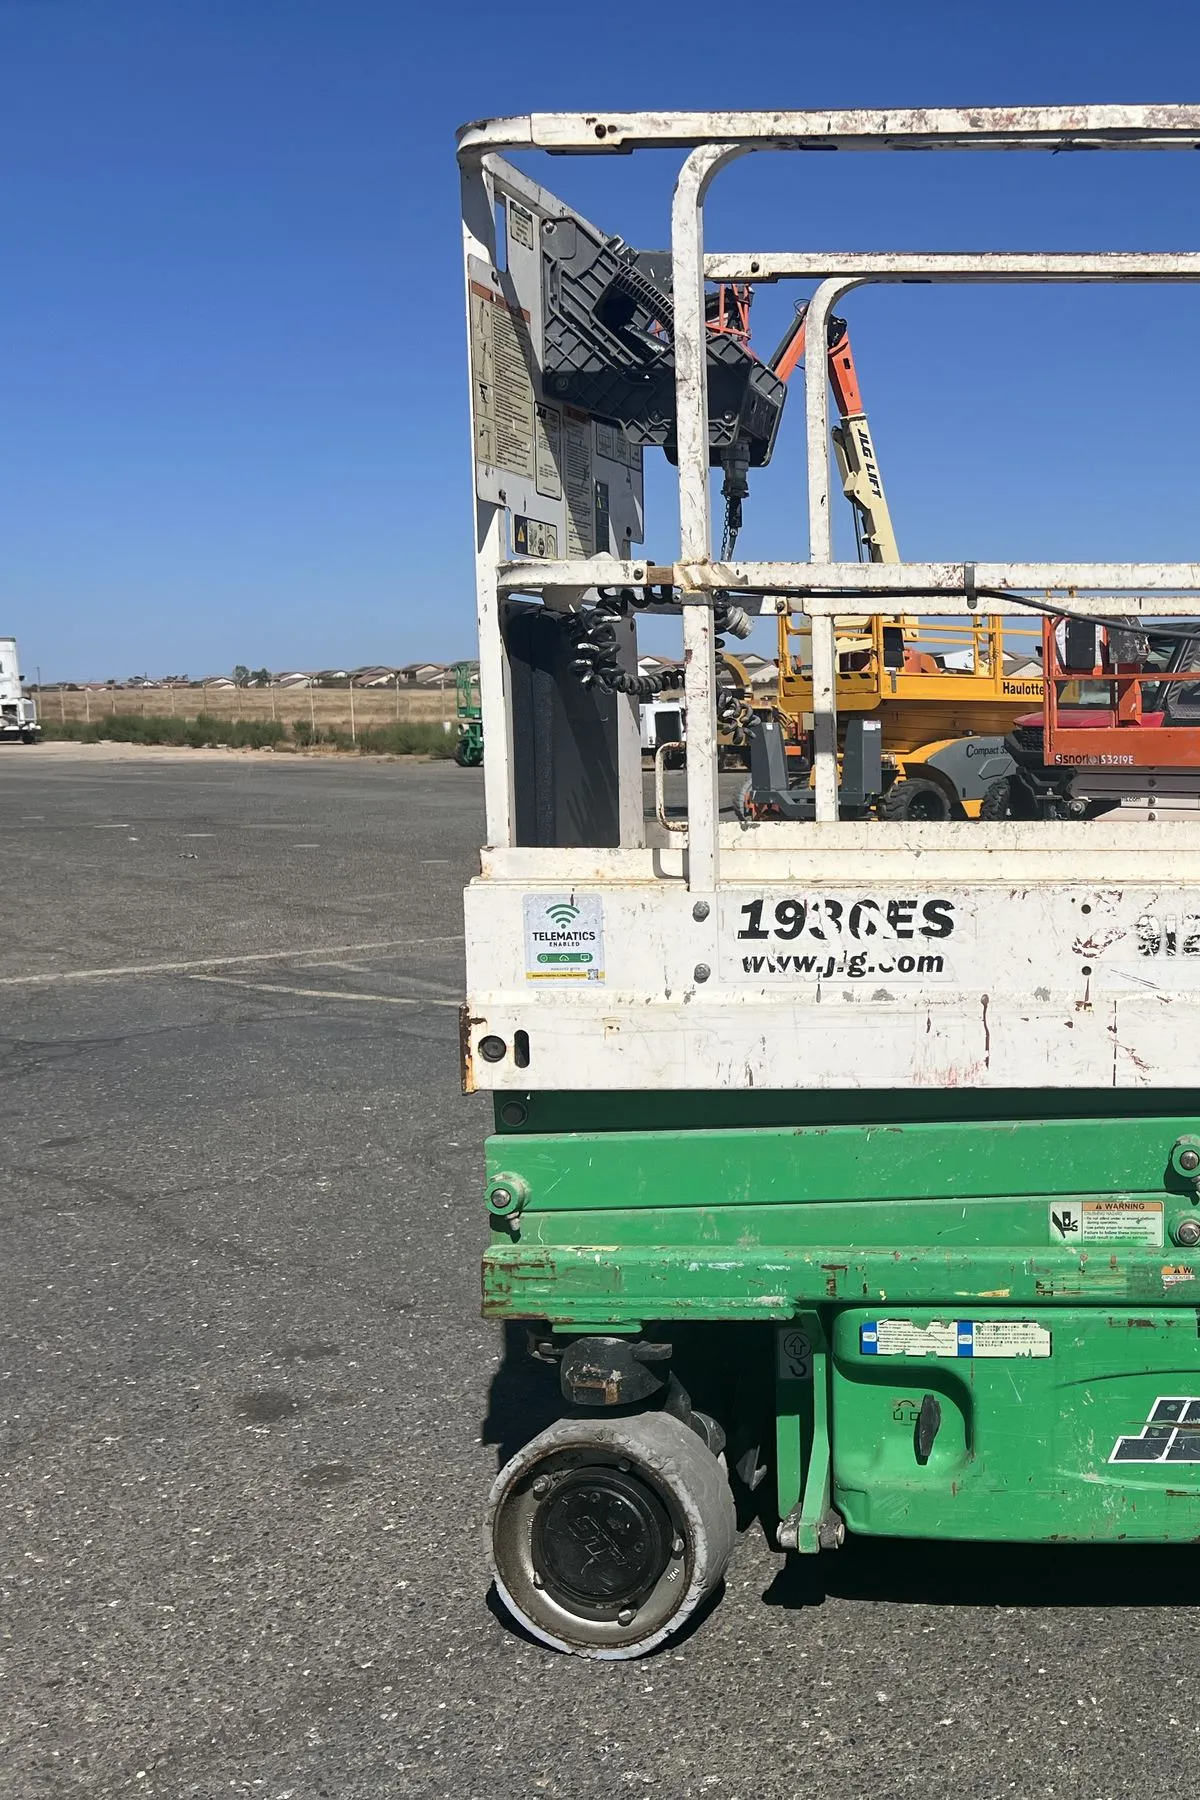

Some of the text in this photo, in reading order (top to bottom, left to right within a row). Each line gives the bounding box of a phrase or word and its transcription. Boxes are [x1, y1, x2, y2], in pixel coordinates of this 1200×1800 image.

[857, 429, 882, 498] JLG LIFT
[1003, 682, 1044, 695] Haulotte
[966, 744, 1000, 758] Compact
[737, 899, 956, 940] 1930ES
[532, 931, 596, 941] TELEMATICS
